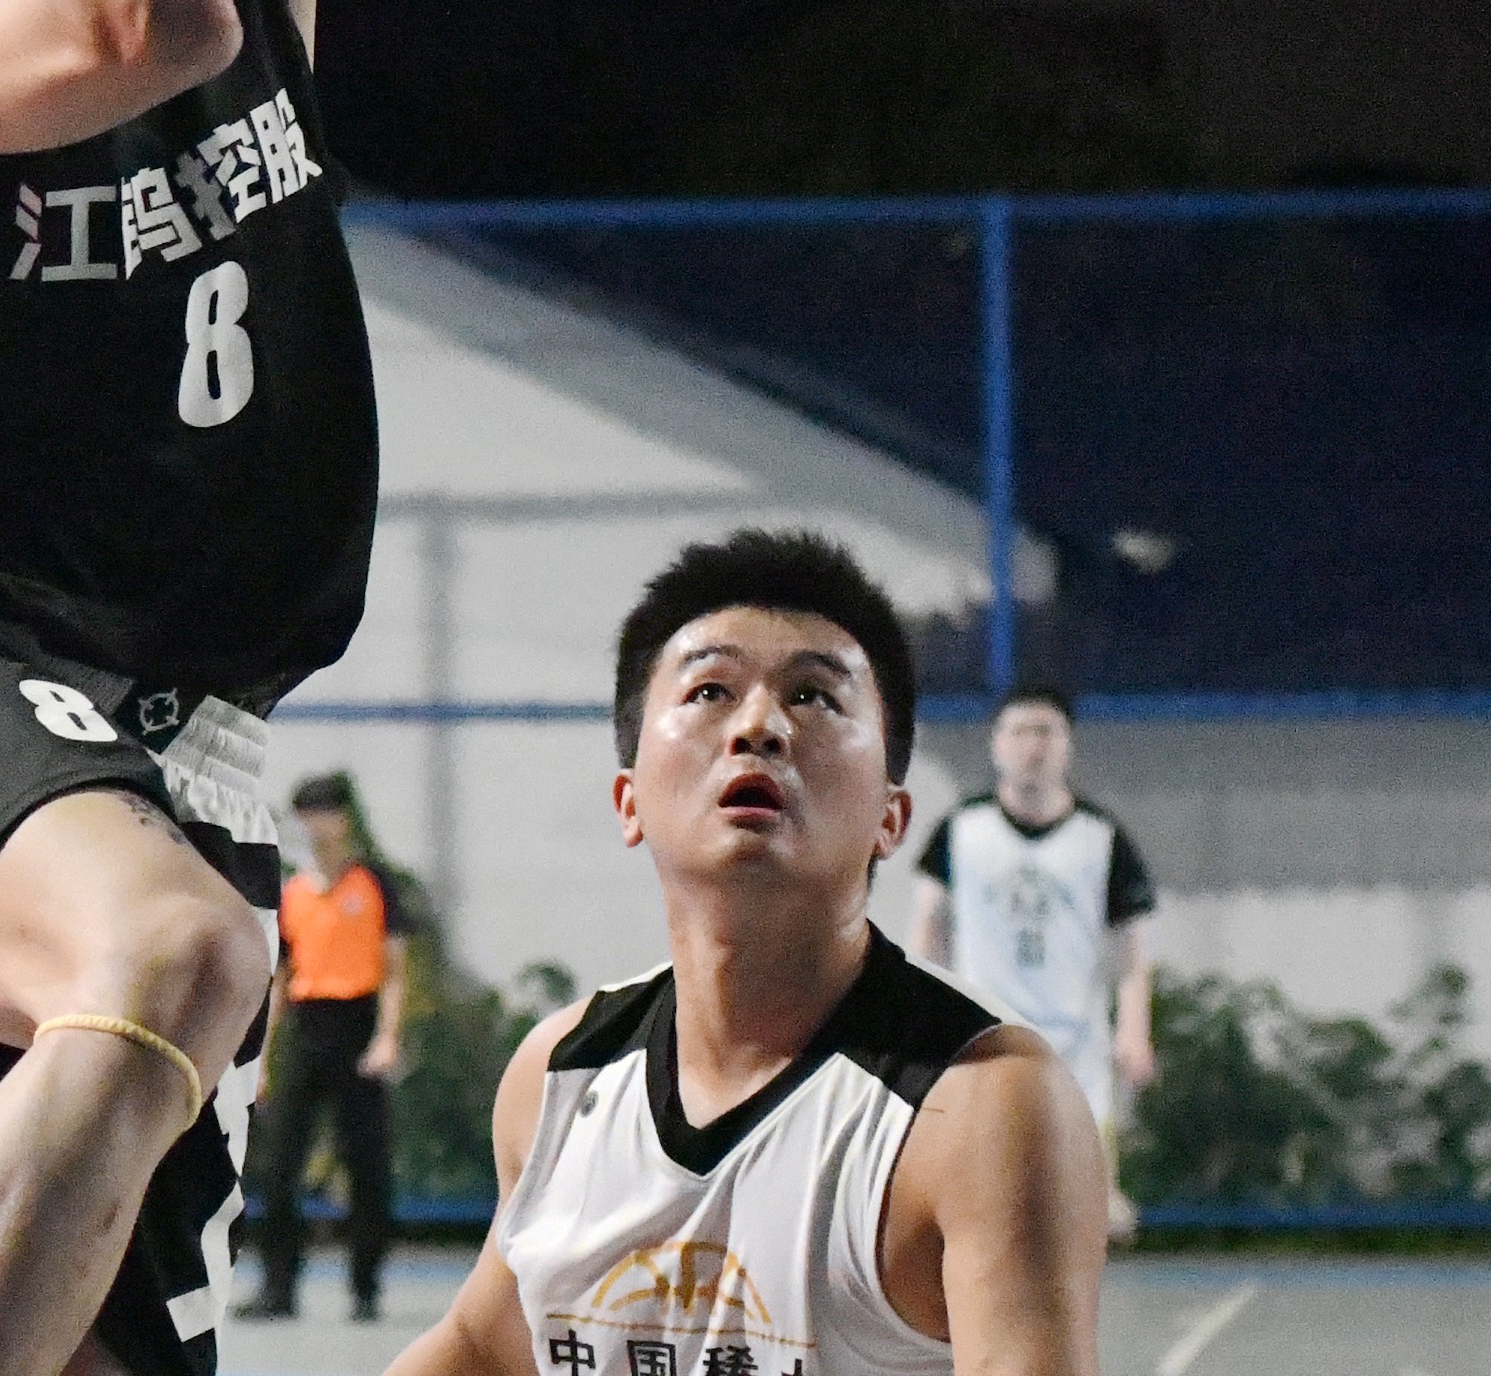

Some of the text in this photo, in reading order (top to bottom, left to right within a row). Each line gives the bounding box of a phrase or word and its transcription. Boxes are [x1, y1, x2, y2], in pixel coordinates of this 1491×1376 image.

[9, 88, 323, 282] 江钨控股
[178, 260, 254, 428] 8
[19, 679, 117, 742] 8
